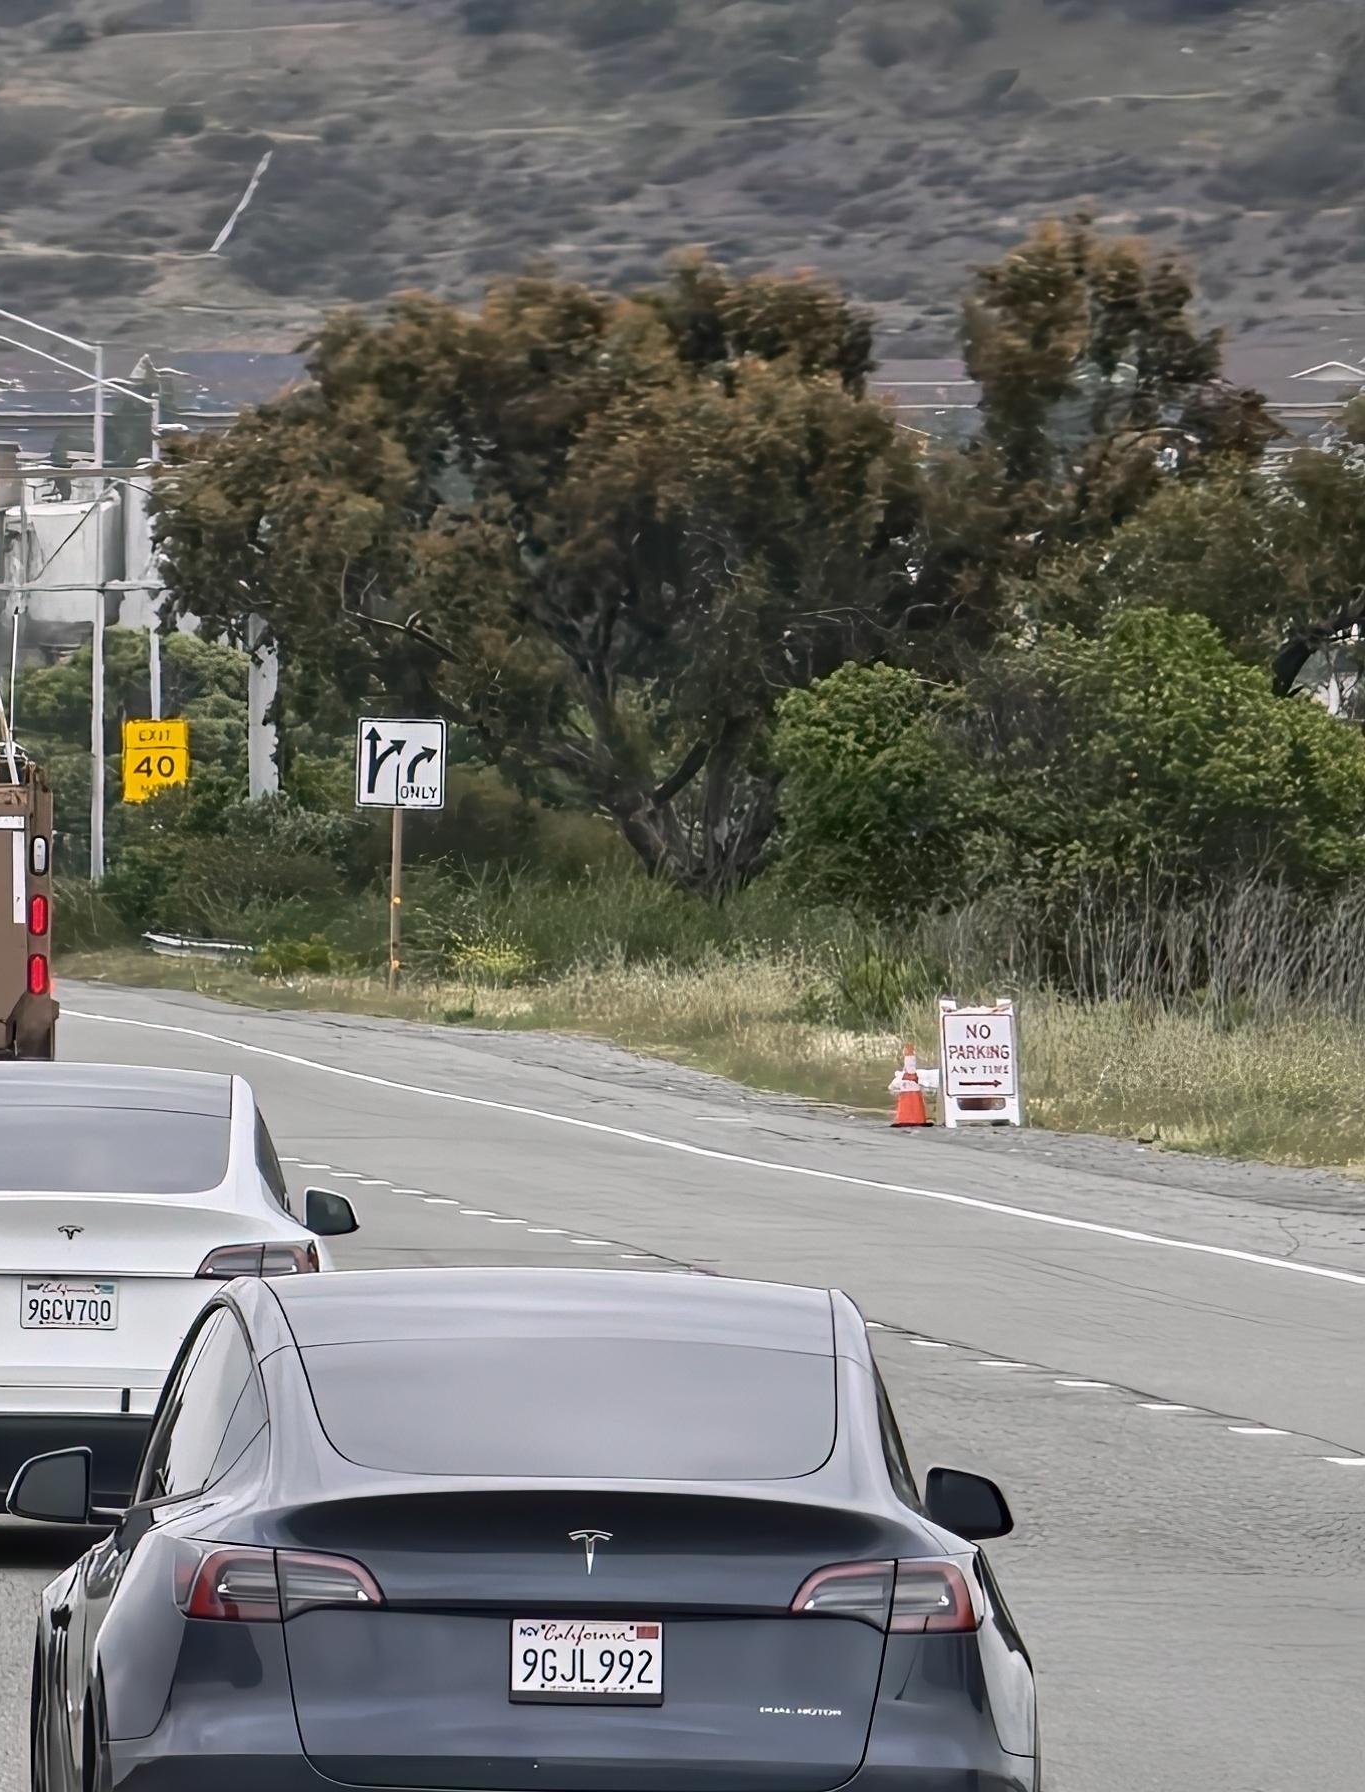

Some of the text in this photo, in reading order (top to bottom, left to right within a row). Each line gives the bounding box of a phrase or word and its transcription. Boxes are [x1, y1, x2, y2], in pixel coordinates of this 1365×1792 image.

[133, 755, 175, 778] 40
[400, 786, 438, 799] ONLY
[966, 1025, 991, 1039] NO
[949, 1045, 1010, 1060] PARKING
[28, 1299, 111, 1322] 9GCV700
[522, 1648, 654, 1684] 9GJL992
